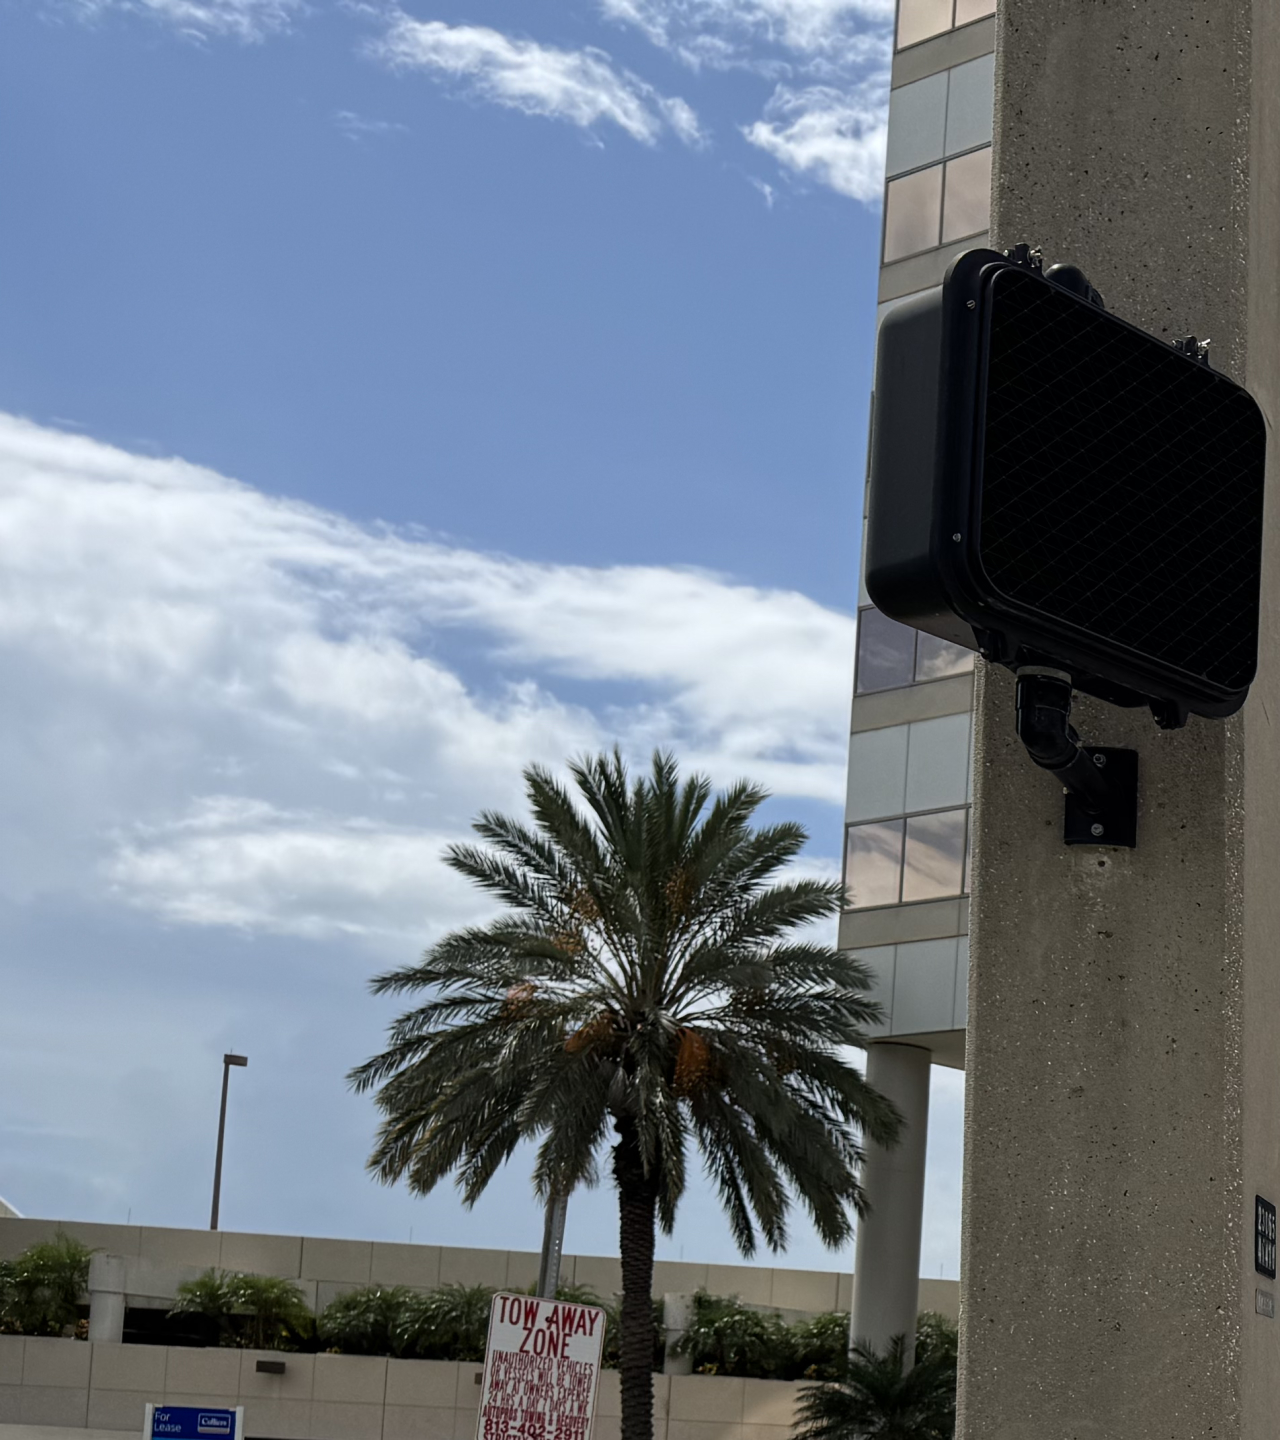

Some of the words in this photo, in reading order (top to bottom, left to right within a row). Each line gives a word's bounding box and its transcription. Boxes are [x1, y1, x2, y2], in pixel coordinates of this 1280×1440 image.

[500, 1296, 540, 1328] TOW
[546, 1305, 600, 1337] AWAY
[519, 1326, 573, 1359] ZONE
[492, 1350, 553, 1371] UNAUTHORIZED
[557, 1359, 593, 1376] VEHICLES
[489, 1379, 508, 1394] AWAY
[524, 1381, 554, 1399] OWNERS
[557, 1384, 590, 1401] EXPENSE
[527, 1396, 540, 1410] DAY
[154, 1422, 182, 1432] Lease
[155, 1411, 171, 1421] For
[482, 1405, 518, 1421] AUTOPROS
[521, 1409, 546, 1424] TOWING
[556, 1413, 590, 1430] RECOVERY
